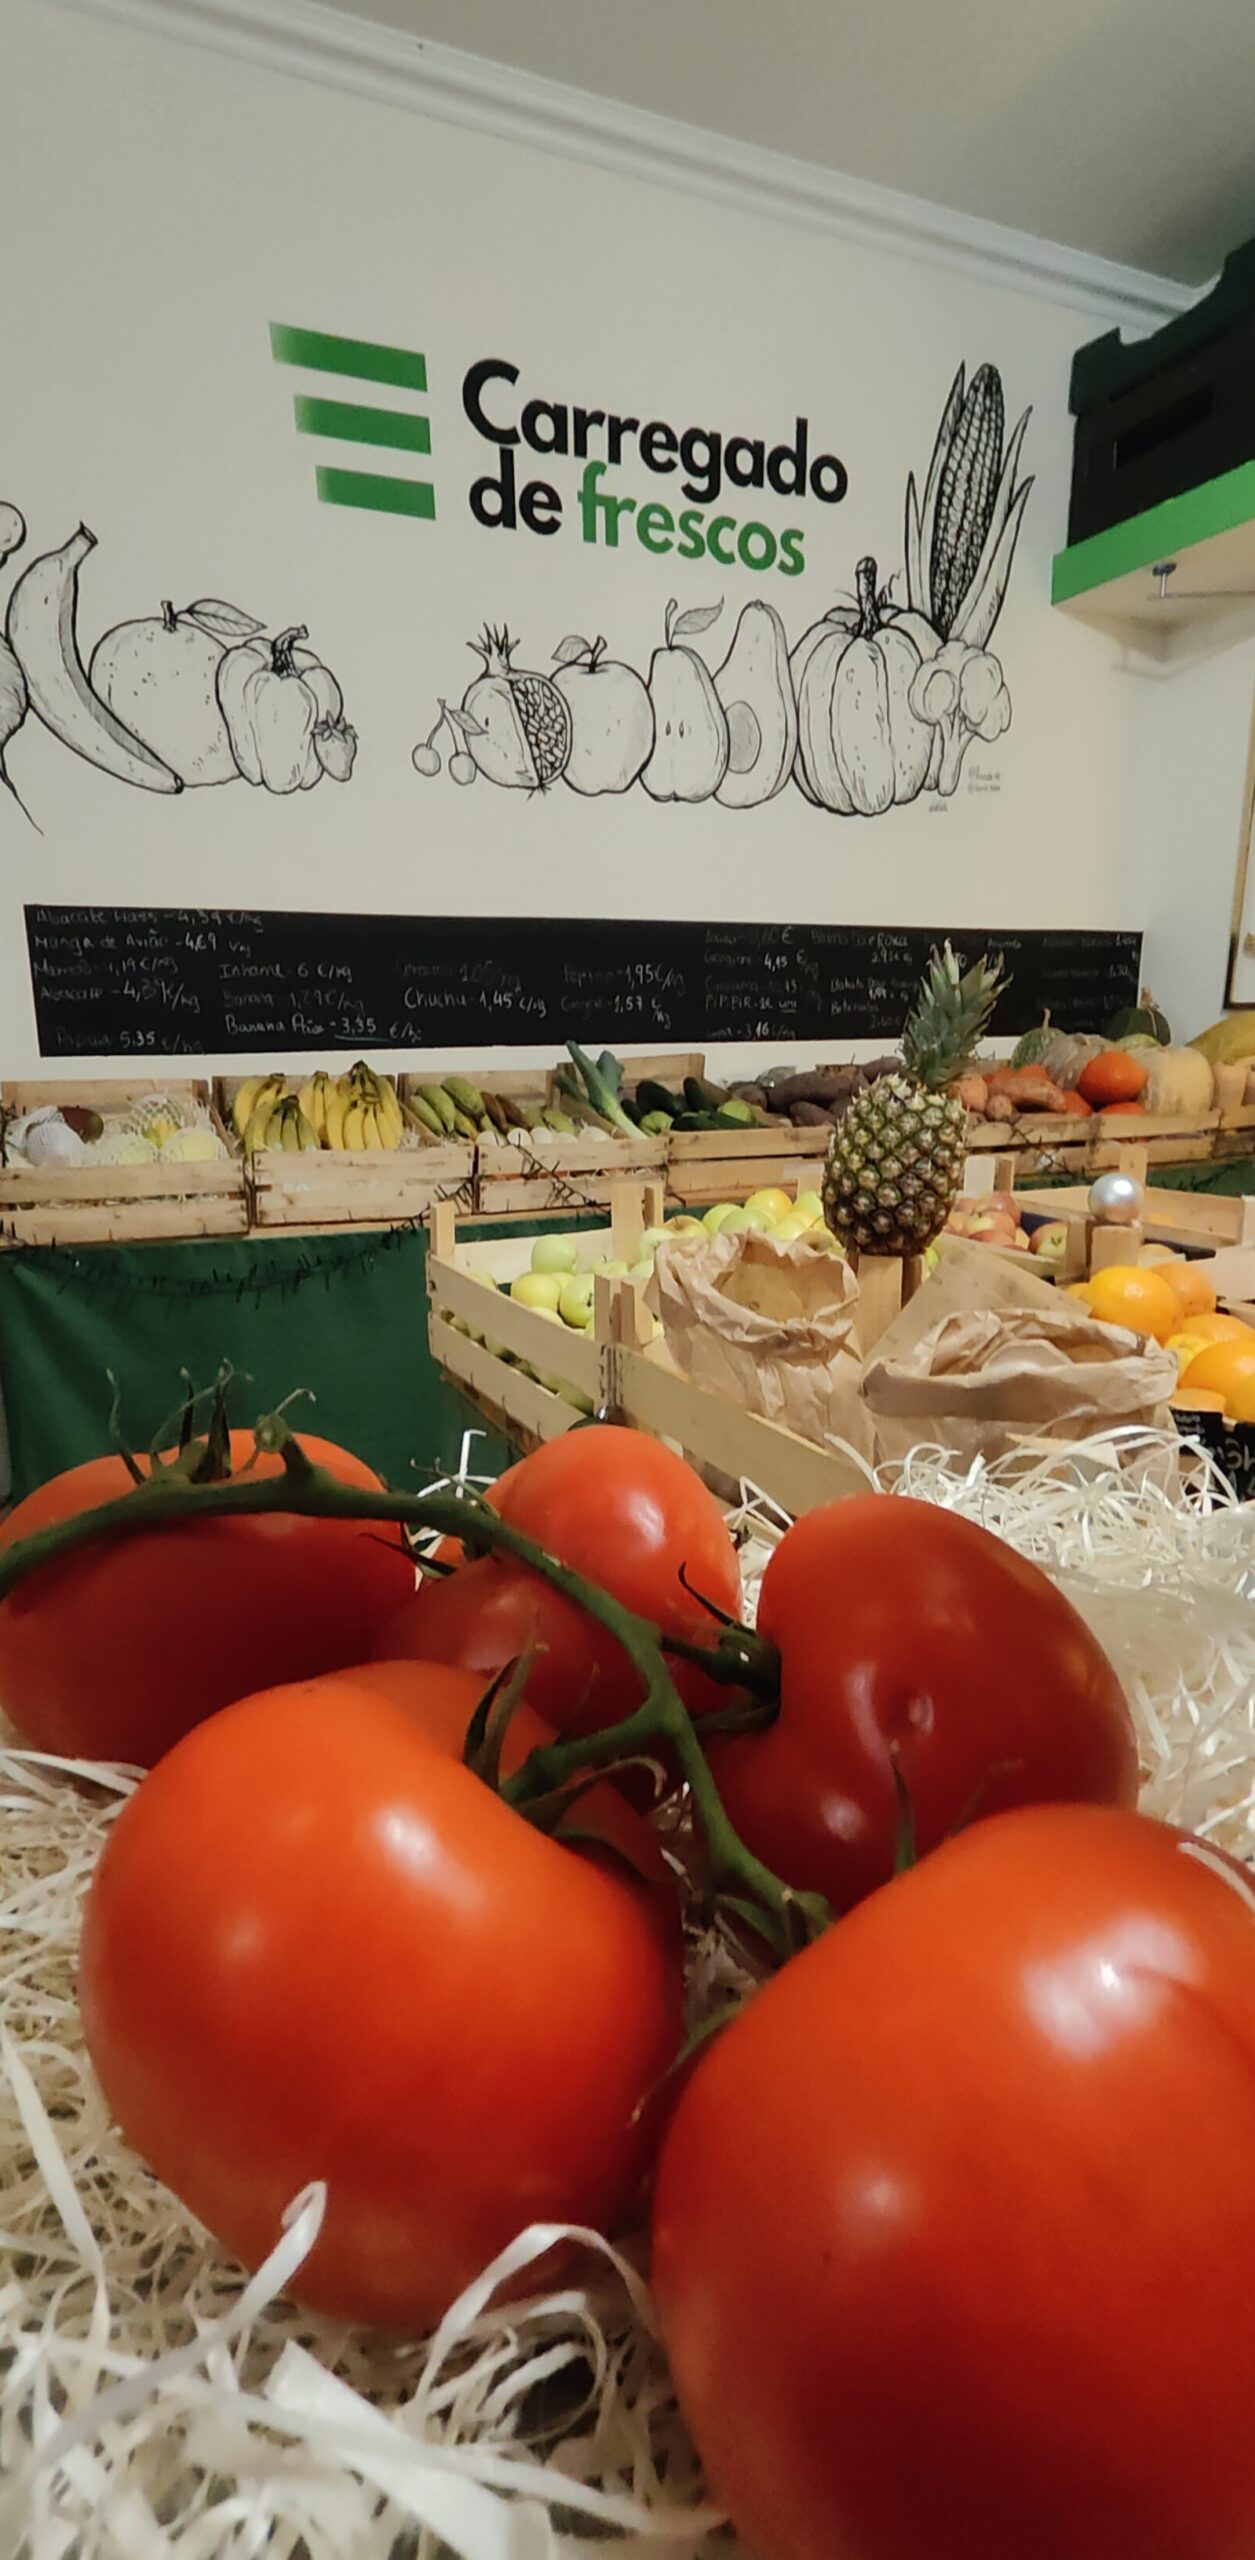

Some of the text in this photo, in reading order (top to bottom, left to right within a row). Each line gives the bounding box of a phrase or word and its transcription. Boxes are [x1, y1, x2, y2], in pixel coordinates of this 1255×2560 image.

[462, 357, 849, 504] Carregado
[468, 445, 806, 577] de frescos
[225, 1013, 285, 1036] Banana
[402, 985, 468, 1010] Chuchu
